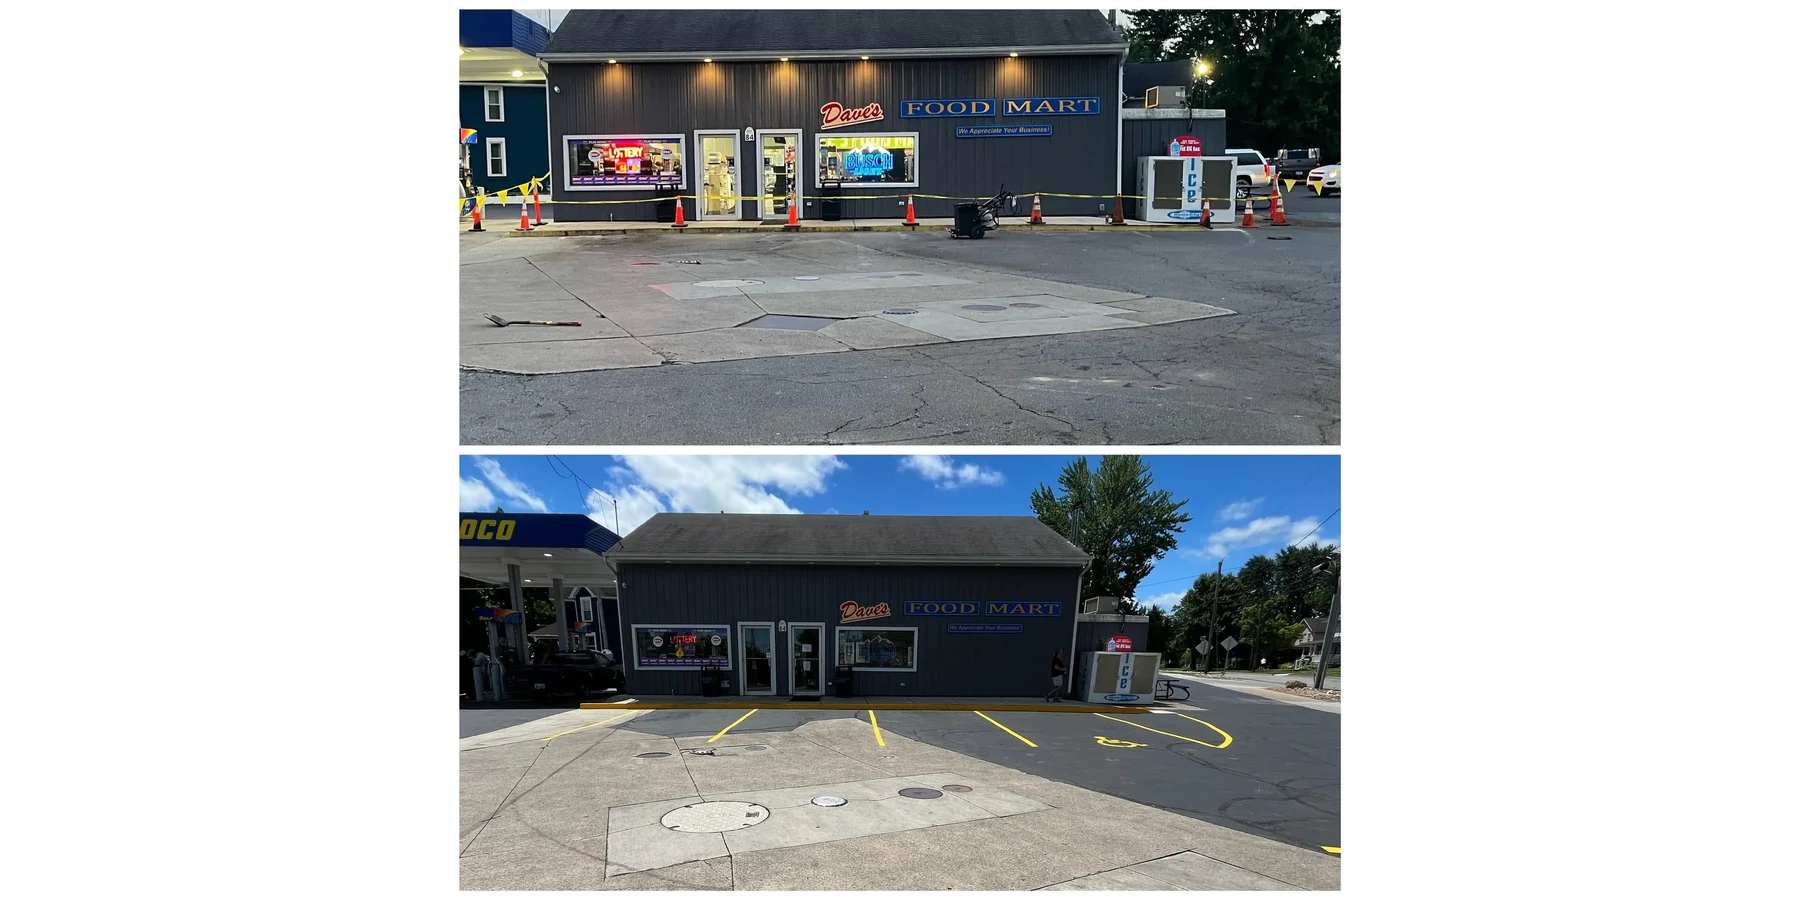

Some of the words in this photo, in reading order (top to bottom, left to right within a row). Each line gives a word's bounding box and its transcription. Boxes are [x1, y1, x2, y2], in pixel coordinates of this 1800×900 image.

[821, 102, 883, 124] Dave's
[906, 101, 990, 115] FOOD
[1006, 99, 1097, 113] MART
[969, 127, 1002, 135] Appreciate
[608, 146, 644, 159] LOTTERY
[845, 153, 893, 169] BUSCH
[460, 519, 516, 541] OCO
[840, 601, 890, 620] Dave's
[909, 602, 976, 614] FOOD
[988, 603, 1059, 614] MART
[669, 635, 697, 644] LOTTERY
